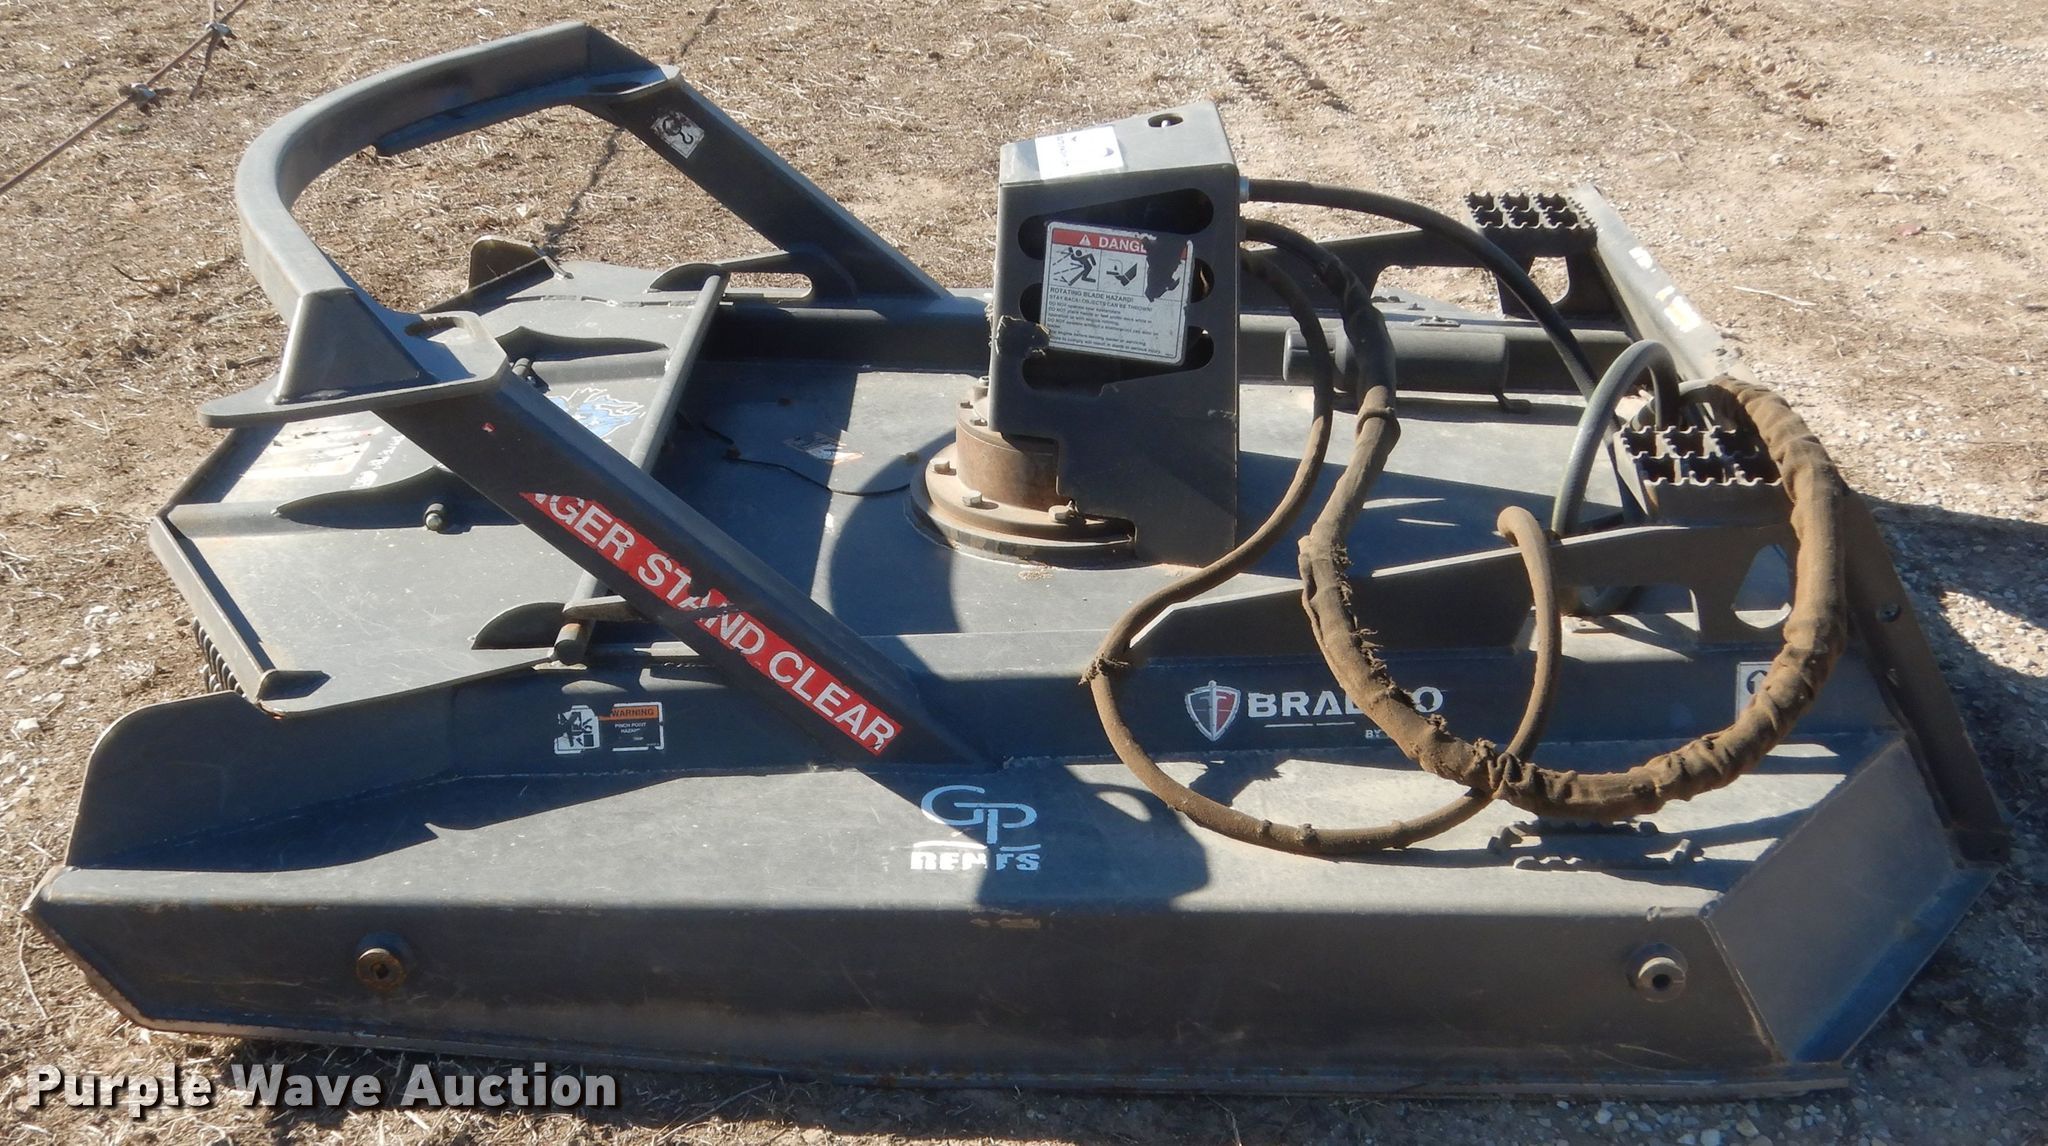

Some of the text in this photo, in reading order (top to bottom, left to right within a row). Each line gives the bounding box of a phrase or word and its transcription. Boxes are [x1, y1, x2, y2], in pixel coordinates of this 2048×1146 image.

[1098, 236, 1148, 254] DANG
[1049, 287, 1082, 296] ROTATING
[1083, 291, 1104, 299] BLADE
[535, 493, 635, 561] GER
[769, 651, 895, 750] CLEAR
[1248, 687, 1444, 717] BRAO
[612, 708, 654, 717] WARNING
